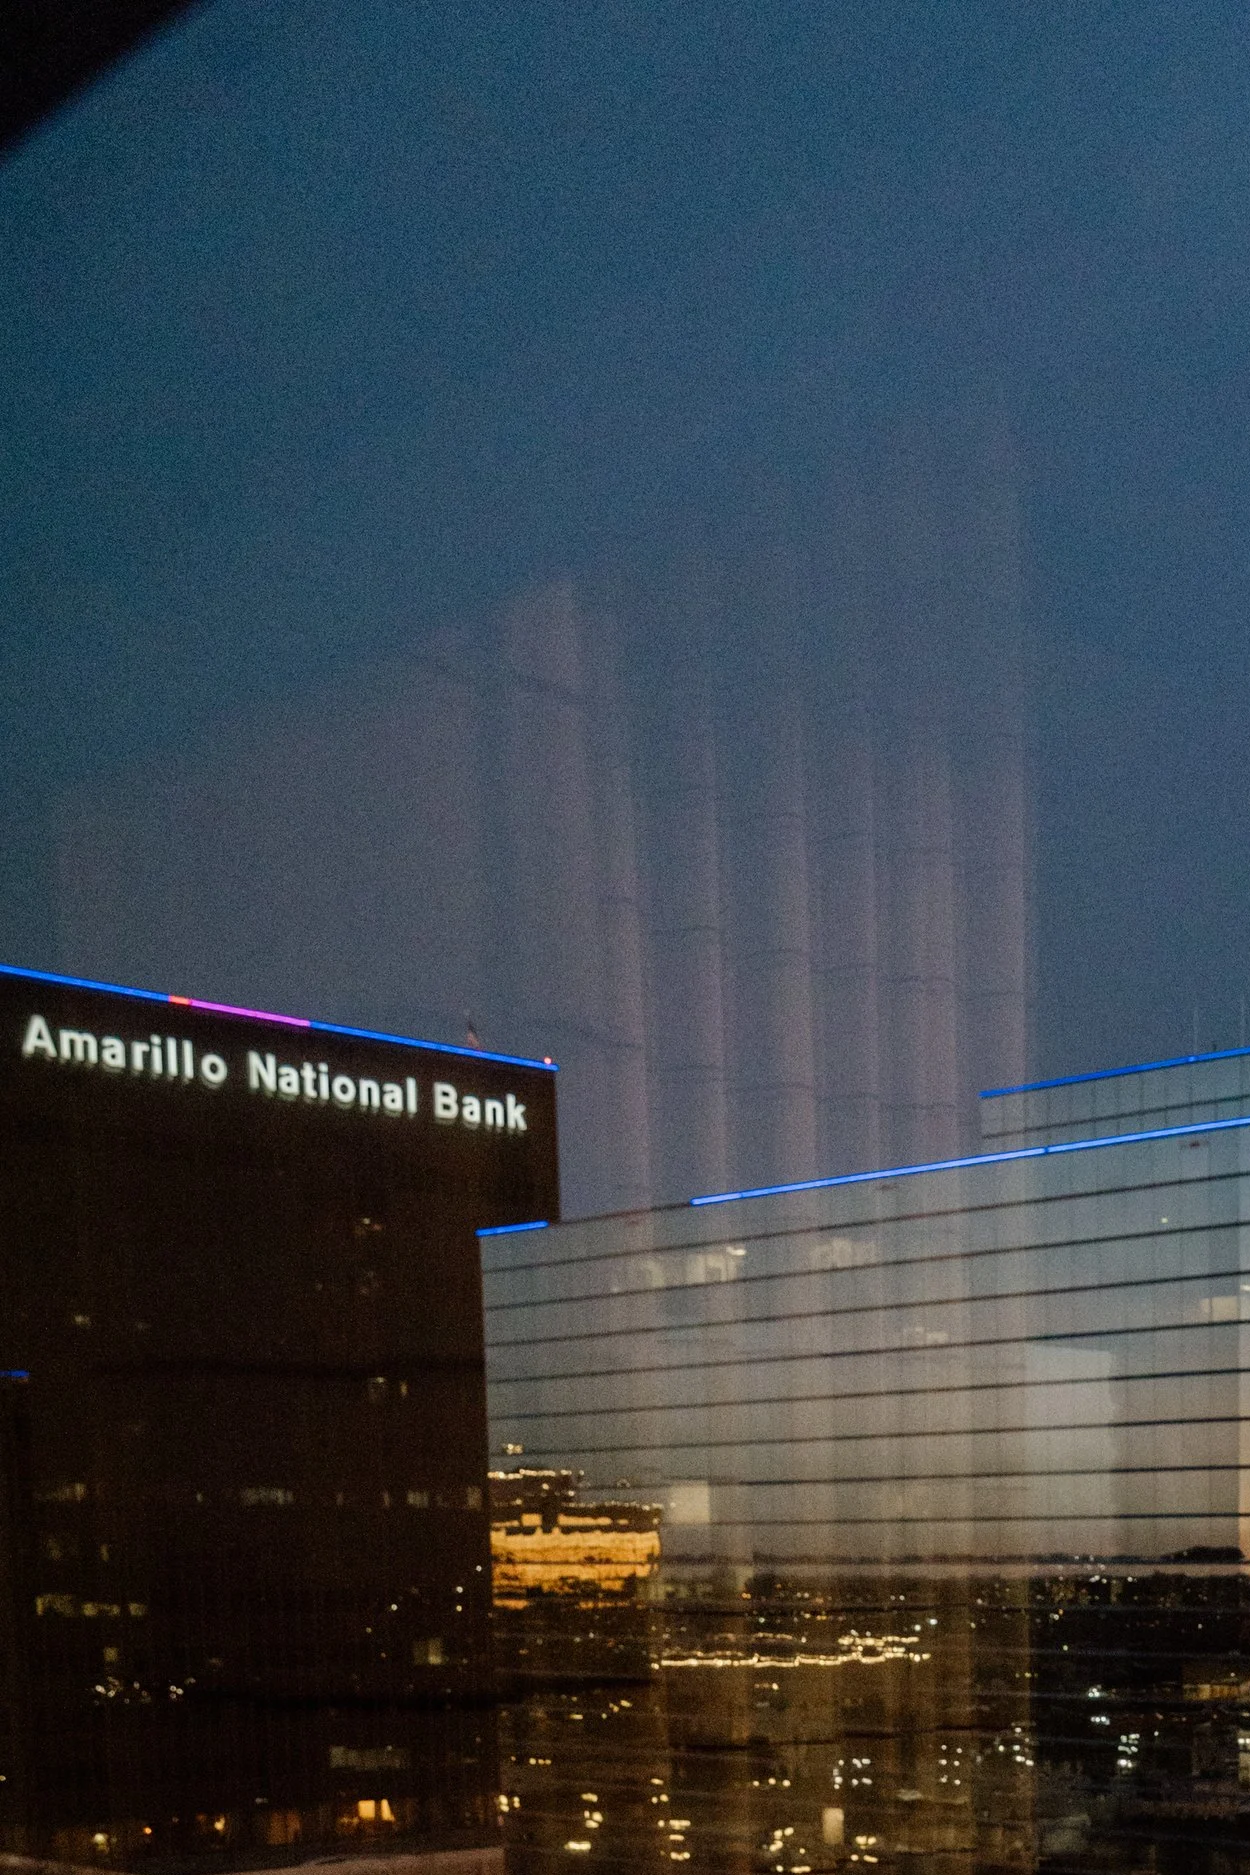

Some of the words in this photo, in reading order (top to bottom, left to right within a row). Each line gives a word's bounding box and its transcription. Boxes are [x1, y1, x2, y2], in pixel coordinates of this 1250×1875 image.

[22, 1014, 228, 1084] Amarillo
[248, 1050, 418, 1115] National
[434, 1081, 528, 1132] Bank
